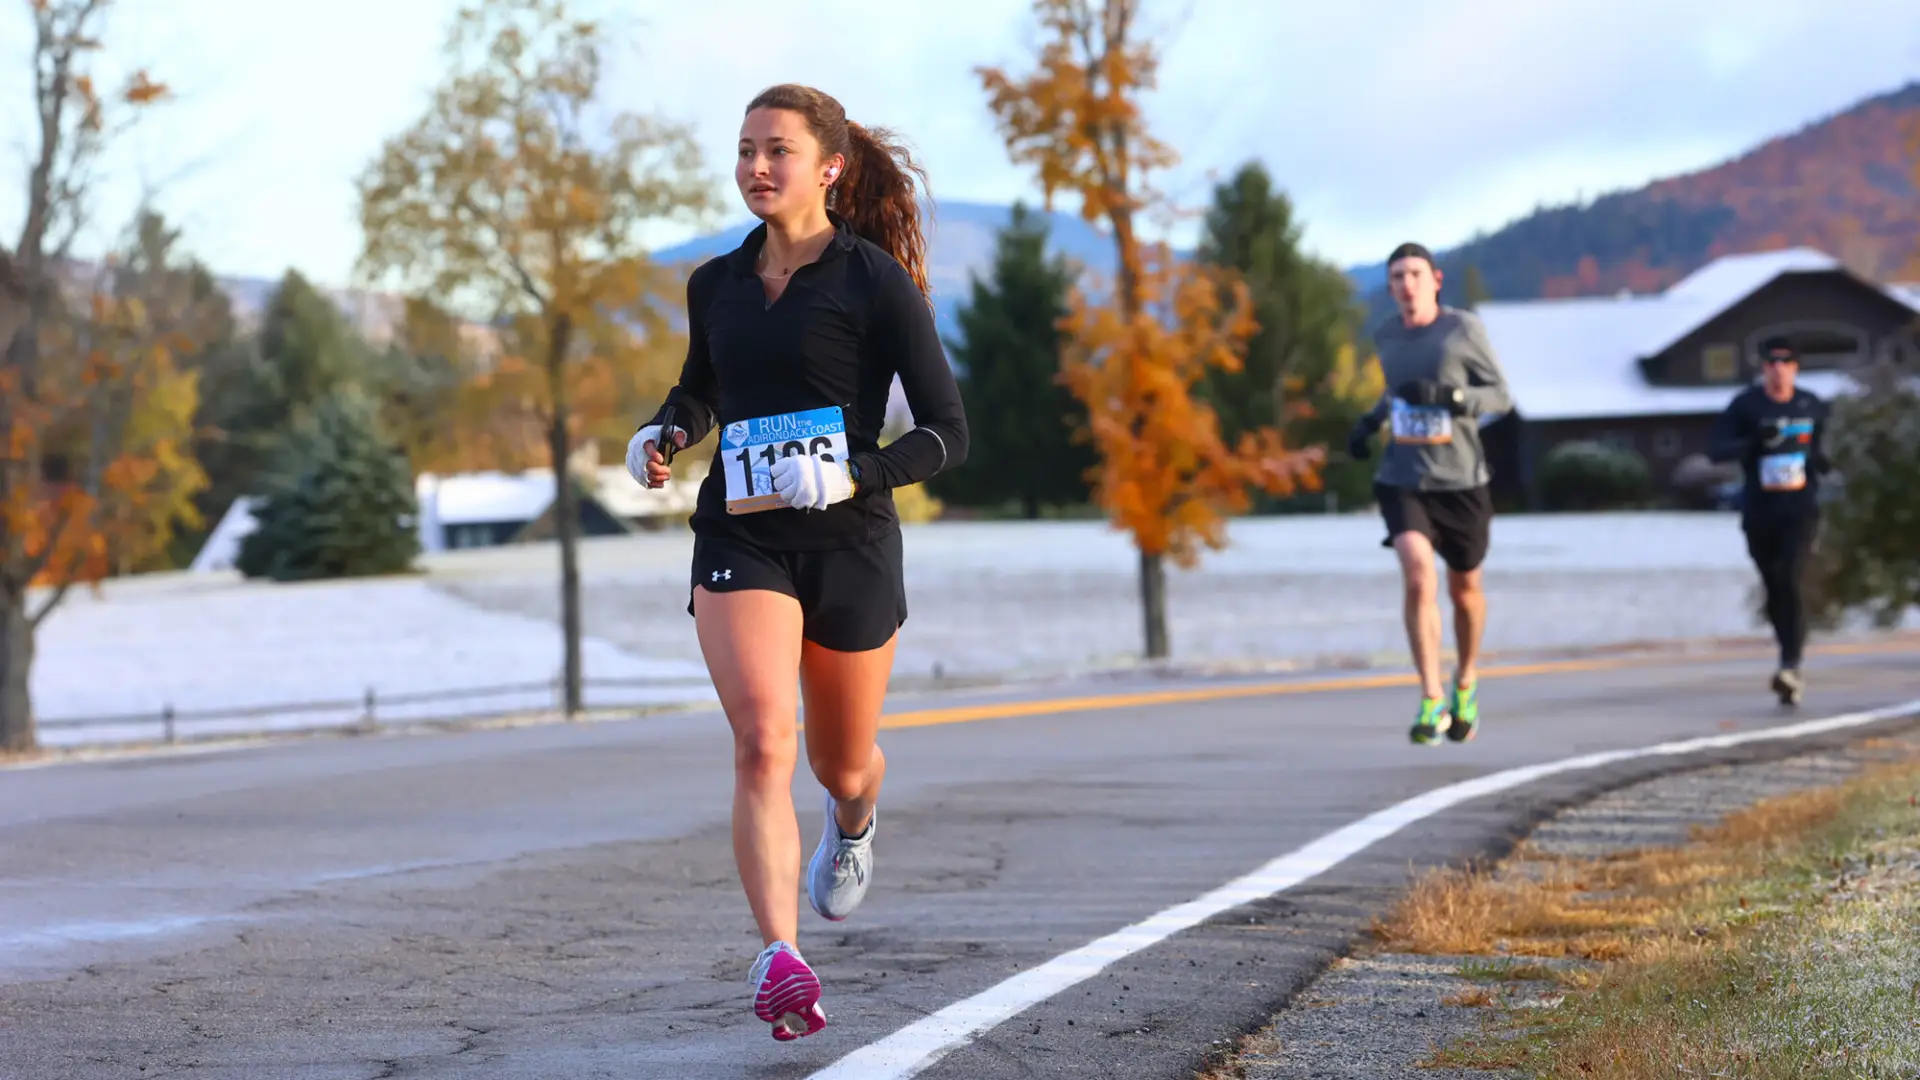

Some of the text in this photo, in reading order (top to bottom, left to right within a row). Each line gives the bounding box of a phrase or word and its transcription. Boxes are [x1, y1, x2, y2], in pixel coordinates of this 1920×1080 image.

[747, 427, 808, 445] ADIRONDACK
[810, 422, 842, 435] COAST
[759, 414, 812, 434] RUN the
